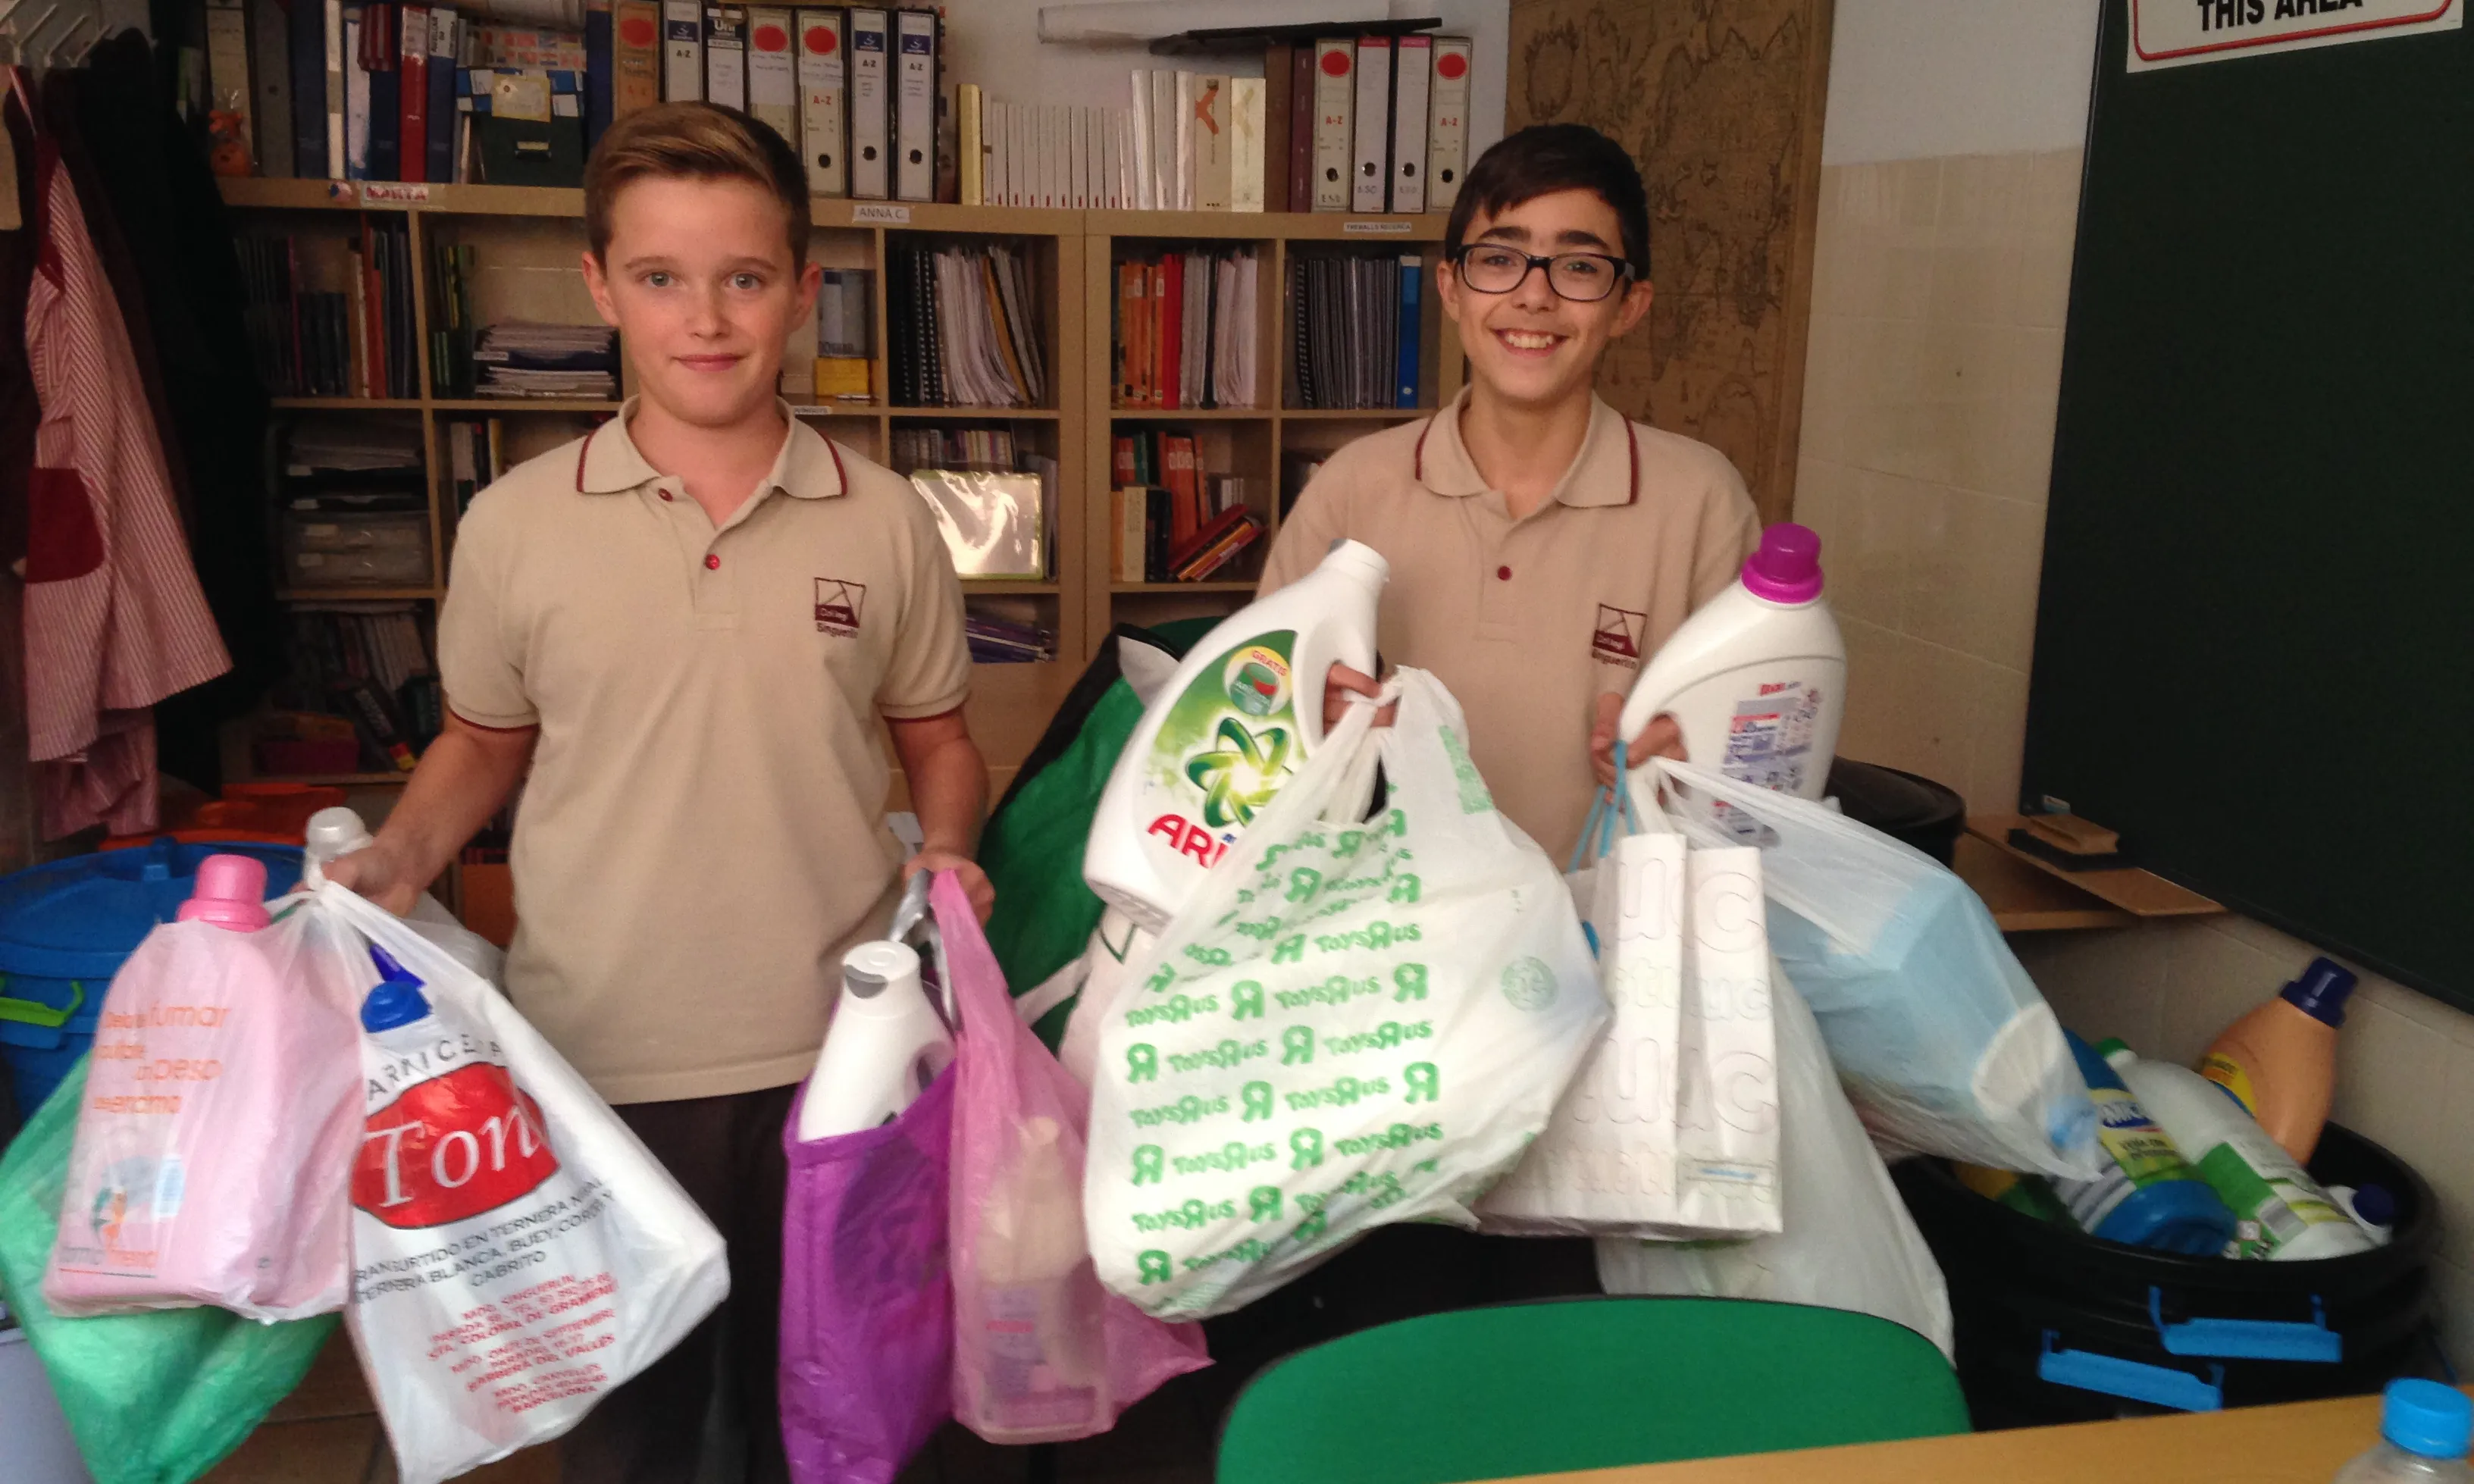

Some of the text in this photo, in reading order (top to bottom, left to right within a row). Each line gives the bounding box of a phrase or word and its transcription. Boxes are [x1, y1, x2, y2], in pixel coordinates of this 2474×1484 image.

[2197, 1, 2264, 31] THIS
[813, 95, 832, 105] A-Z
[1326, 116, 1343, 125] A-Z
[1441, 117, 1458, 127] A-Z
[860, 207, 892, 218] ANNA
[1252, 650, 1287, 677] GRATIS
[463, 1232, 489, 1250] EN
[489, 1201, 570, 1237] TERNERA
[470, 1250, 546, 1287] CABRITO
